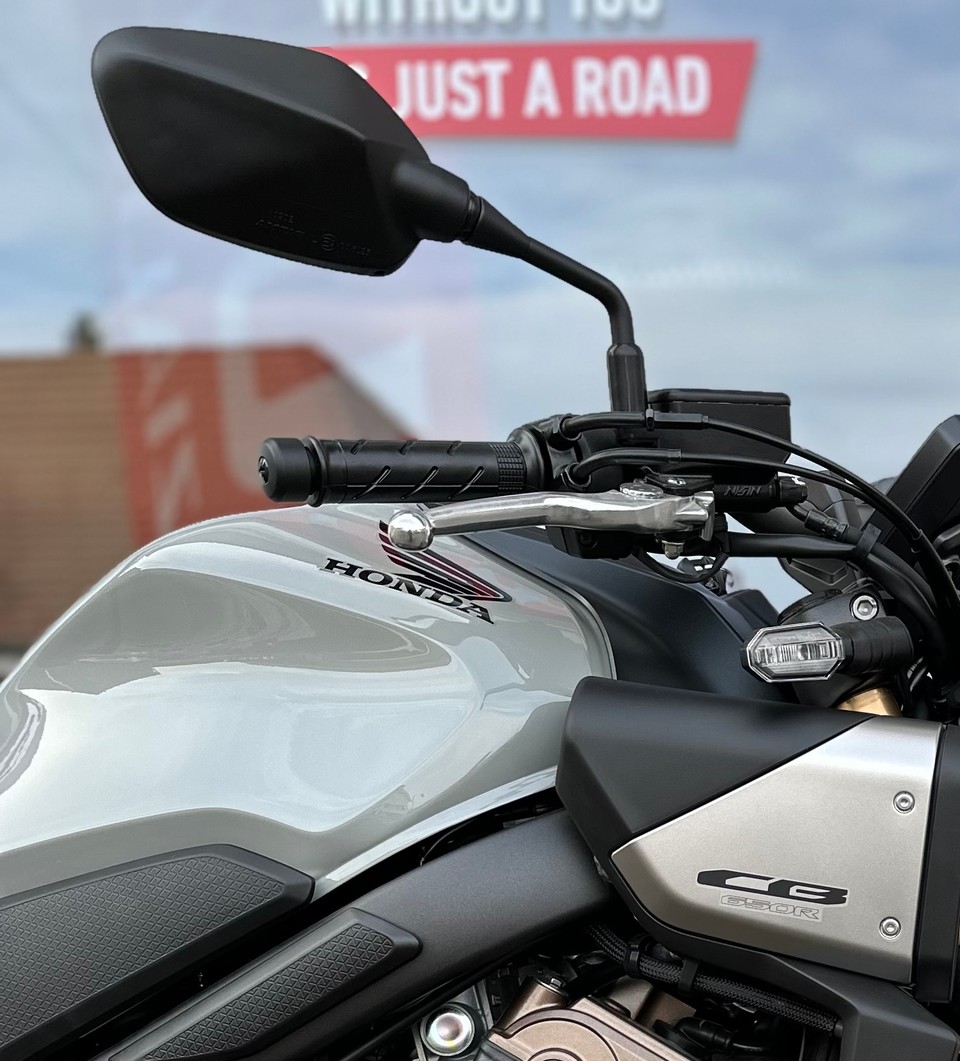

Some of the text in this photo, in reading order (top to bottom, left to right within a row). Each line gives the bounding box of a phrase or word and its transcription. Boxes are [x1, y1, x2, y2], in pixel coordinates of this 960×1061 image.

[395, 55, 711, 121] JUST A ROAD
[319, 558, 494, 625] HONDA
[697, 870, 848, 905] CB
[721, 895, 820, 920] 650R
